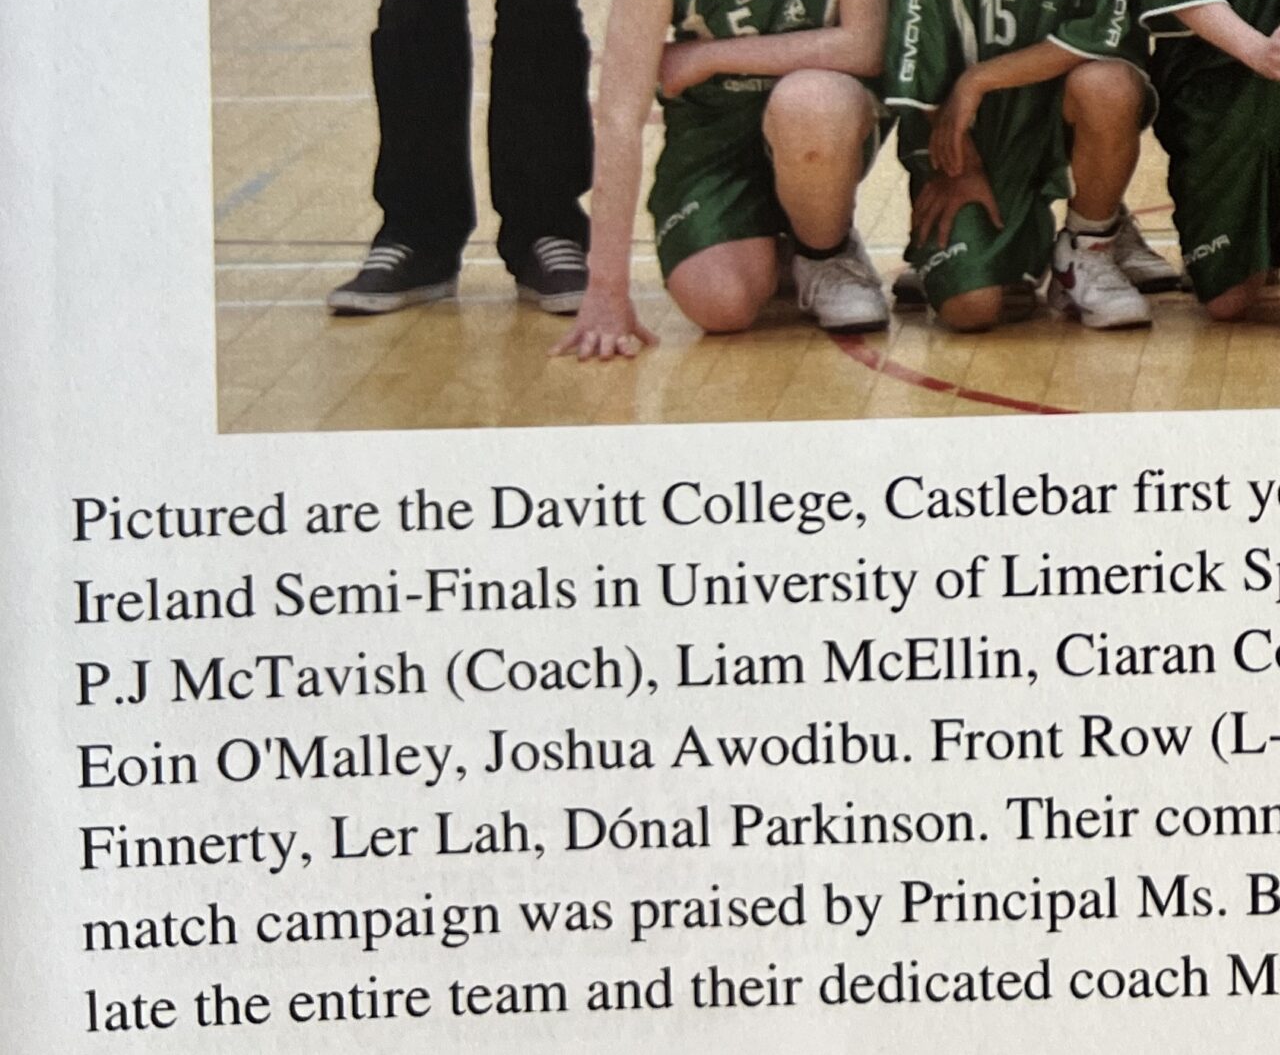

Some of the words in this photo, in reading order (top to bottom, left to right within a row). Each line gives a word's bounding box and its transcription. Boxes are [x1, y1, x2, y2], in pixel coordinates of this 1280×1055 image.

[71, 491, 288, 542] Pictured
[305, 501, 381, 535] are
[397, 487, 475, 533] the
[490, 482, 647, 530] Davitt
[661, 479, 867, 536] College,
[884, 472, 1118, 521] Castlebar
[1132, 468, 1232, 514] first
[72, 573, 257, 625] Ireland
[274, 565, 577, 617] Semi-Finals
[594, 563, 641, 609] in
[656, 557, 919, 615] University
[934, 554, 990, 600] of
[1000, 548, 1227, 599] Limerick
[74, 659, 152, 707] P.J
[169, 650, 428, 703] McTavish
[445, 644, 659, 703] (Coach),
[675, 641, 806, 688] Liam
[822, 634, 1038, 687] McEllin,
[1055, 631, 1217, 678] Ciaran
[76, 740, 199, 789] Eoin
[216, 733, 467, 789] O'Malley,
[484, 727, 656, 774] Joshua
[670, 720, 912, 769] Awodibu.
[929, 717, 1065, 763] Front
[1078, 714, 1193, 759] Row
[78, 824, 312, 876] Finnerty,
[329, 815, 419, 860] Ler
[434, 809, 545, 860] Lah,
[562, 804, 711, 852] Dónal
[729, 800, 989, 848] Parkinson.
[1005, 793, 1140, 841] Their
[82, 901, 239, 952] match
[256, 892, 502, 953] campaign
[518, 899, 614, 933] was
[629, 882, 808, 944] praised
[822, 882, 884, 938] by
[899, 875, 1119, 934] Principal
[1136, 873, 1227, 919] Ms.
[84, 988, 178, 1033] late
[193, 982, 272, 1028] the
[288, 975, 432, 1024] entire
[448, 980, 569, 1017] team
[586, 965, 675, 1012] and
[690, 962, 804, 1010] their
[818, 957, 1053, 1006] dedicated
[1068, 954, 1210, 1001] coach
